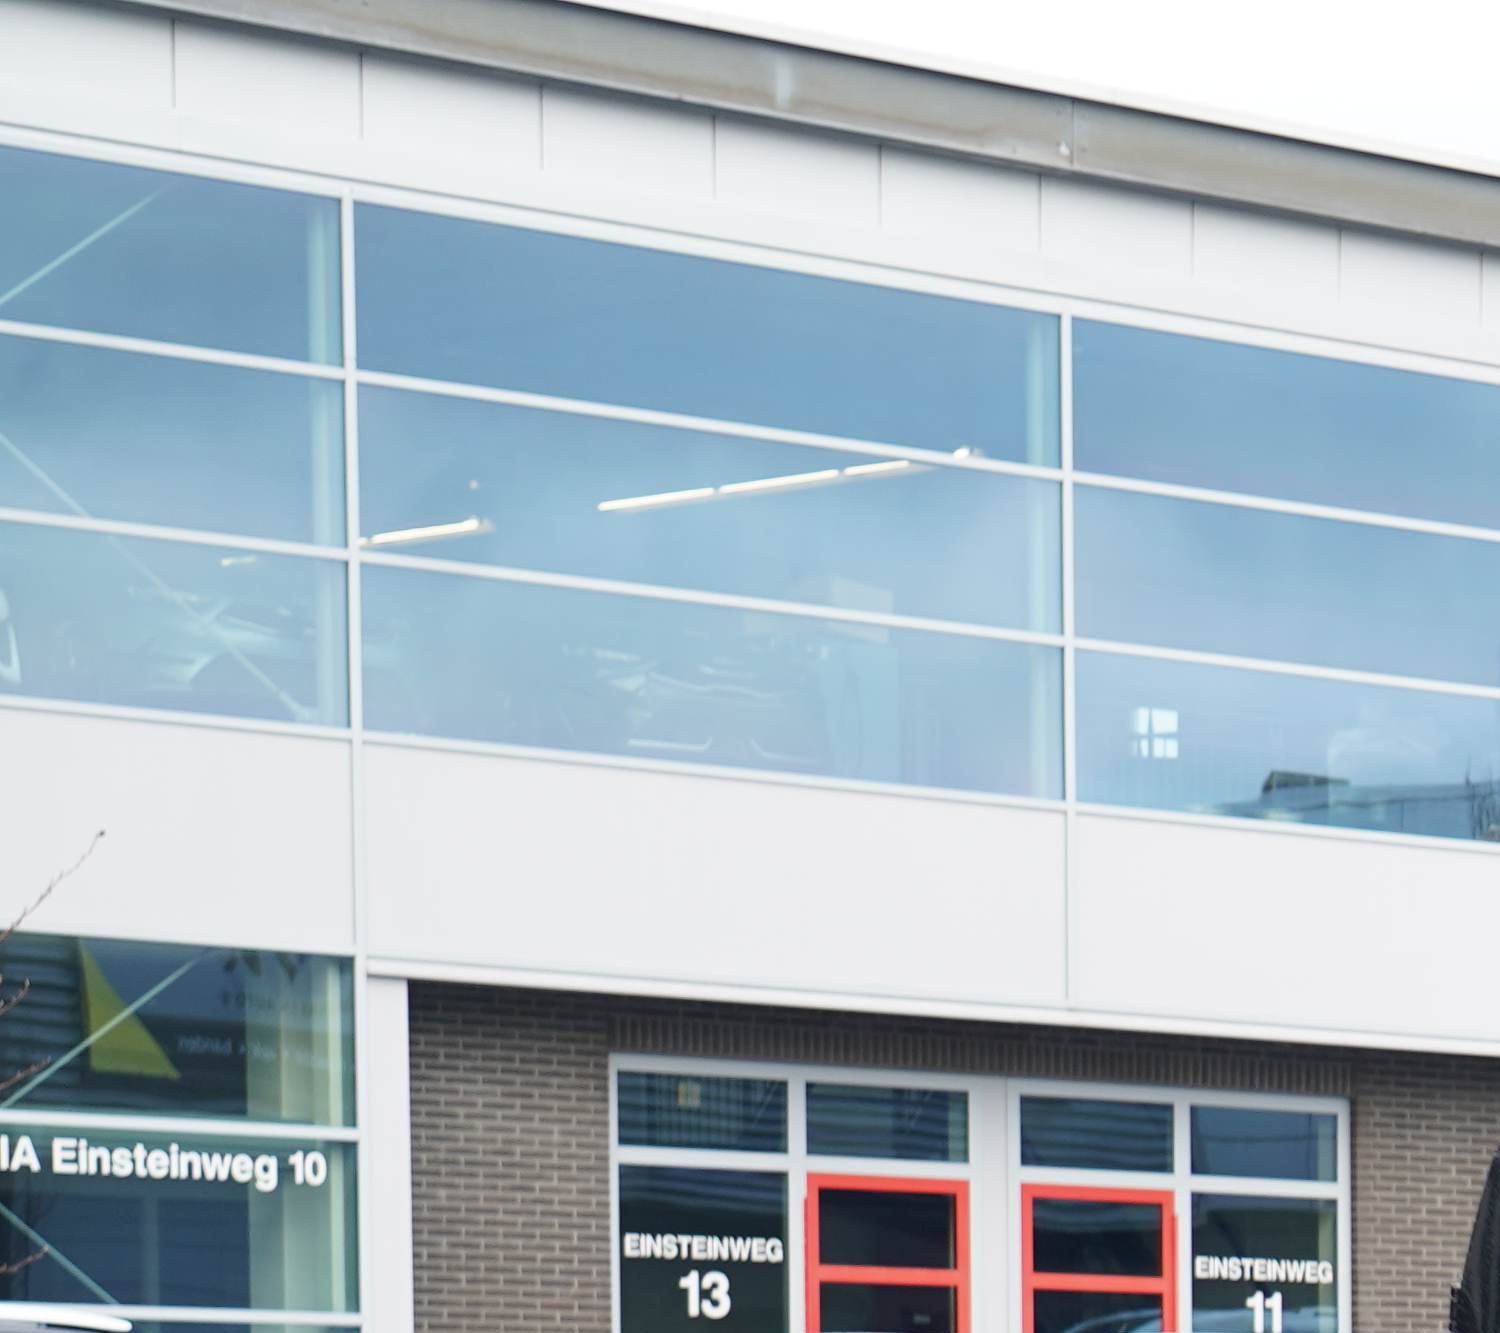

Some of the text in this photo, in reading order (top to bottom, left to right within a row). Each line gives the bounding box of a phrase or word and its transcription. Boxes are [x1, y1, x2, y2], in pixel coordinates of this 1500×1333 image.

[52, 1136, 279, 1193] Einsteinweg
[288, 1150, 328, 1187] 10
[623, 1231, 785, 1264] EINSTEINWEG
[1194, 1254, 1334, 1285] EINSTEINWEG
[678, 1270, 732, 1320] 13
